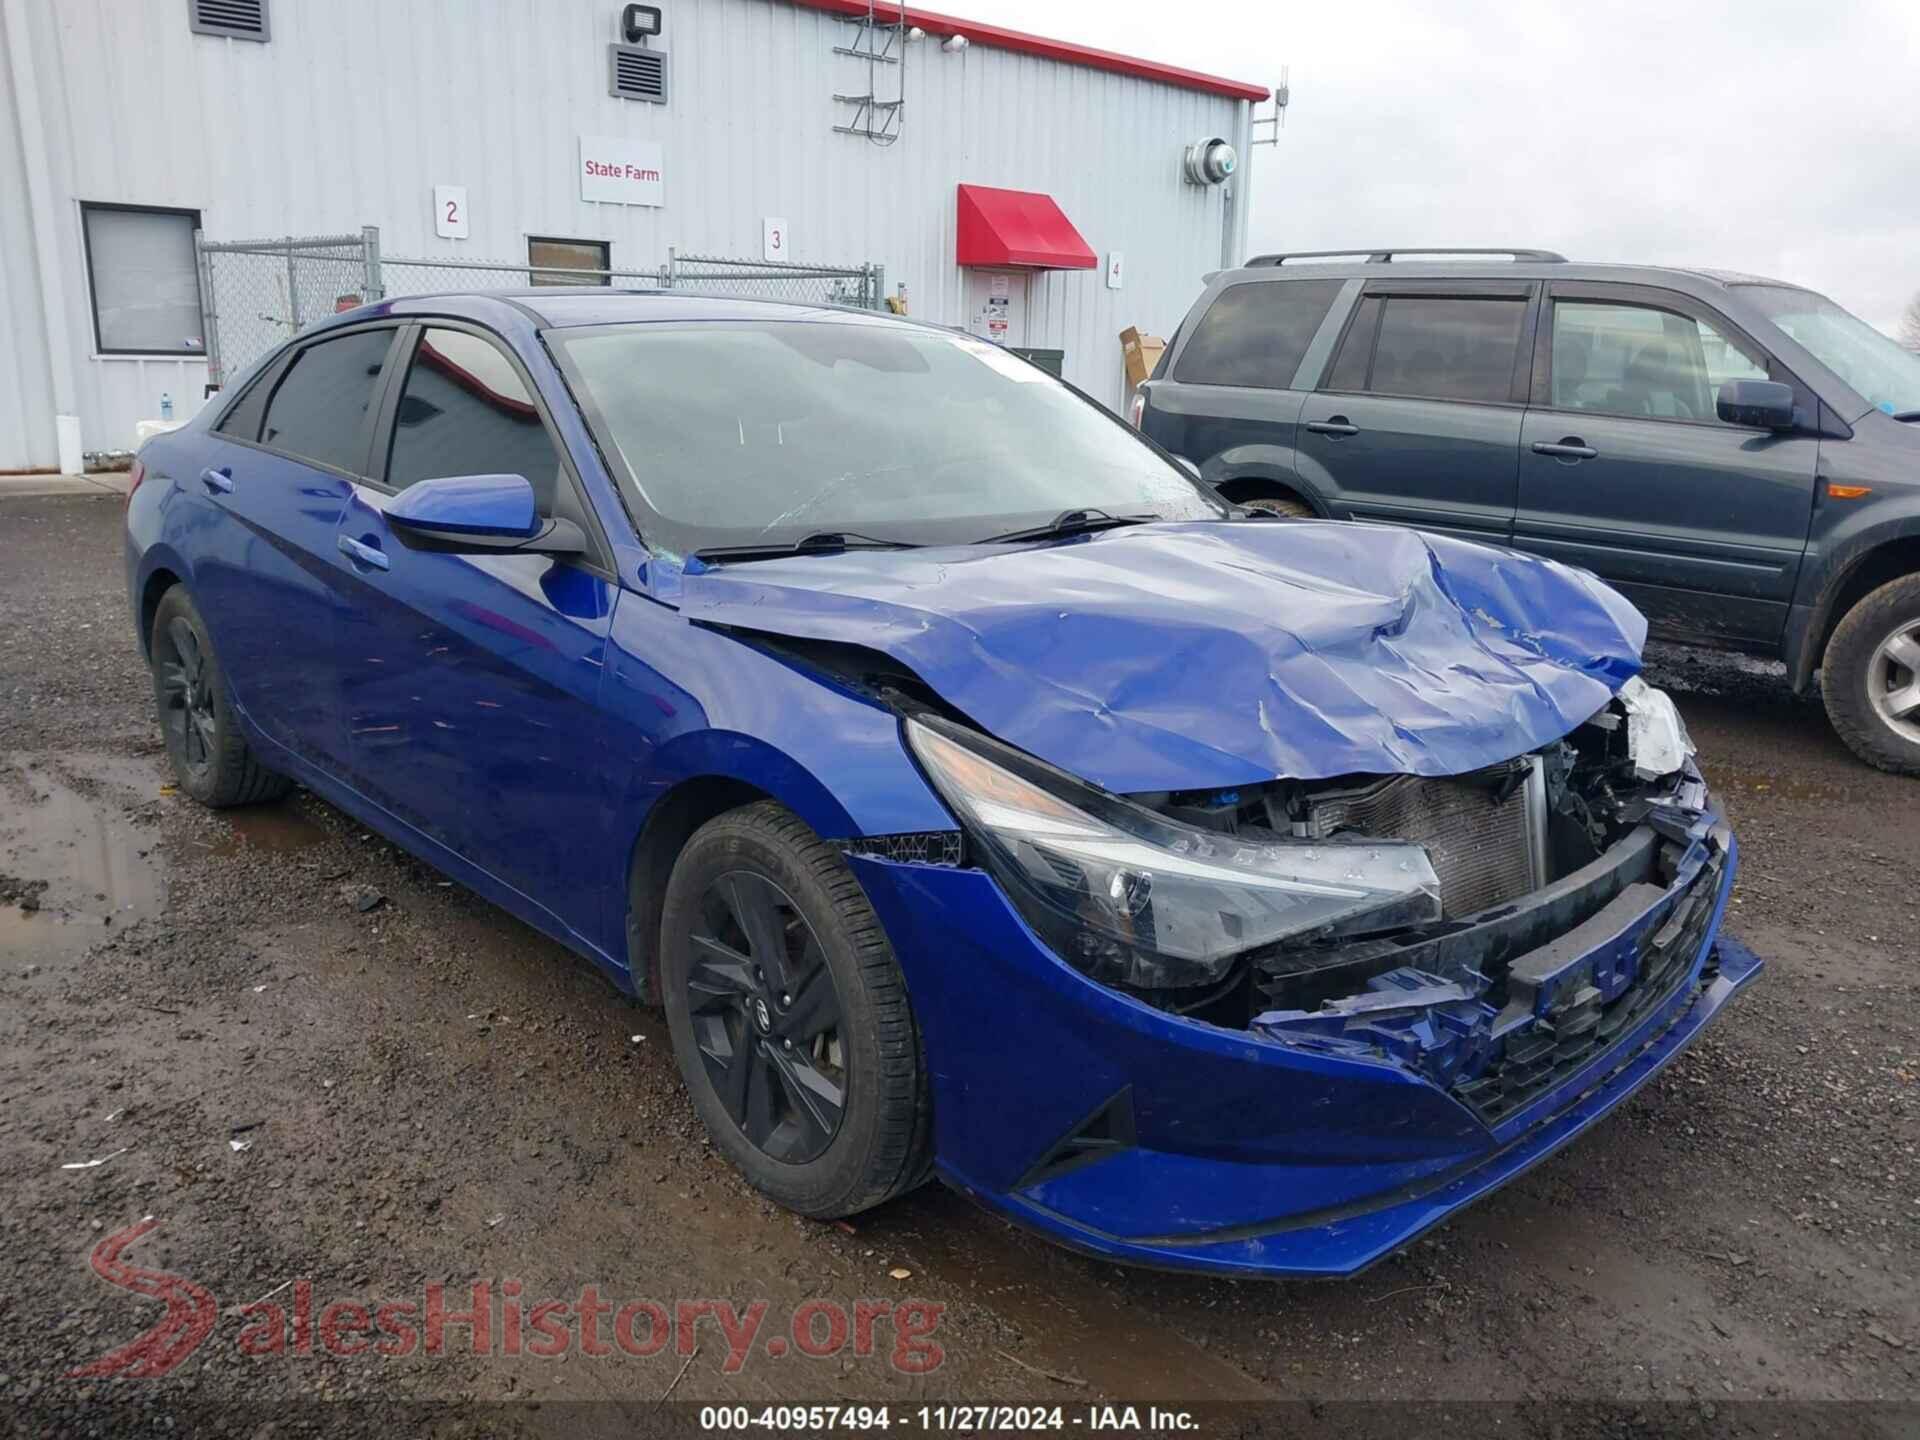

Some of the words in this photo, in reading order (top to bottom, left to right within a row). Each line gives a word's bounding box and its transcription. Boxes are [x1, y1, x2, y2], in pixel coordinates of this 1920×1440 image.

[585, 160, 621, 178] State
[625, 164, 660, 181] Farm
[446, 201, 458, 223] 2
[771, 230, 781, 249] 3
